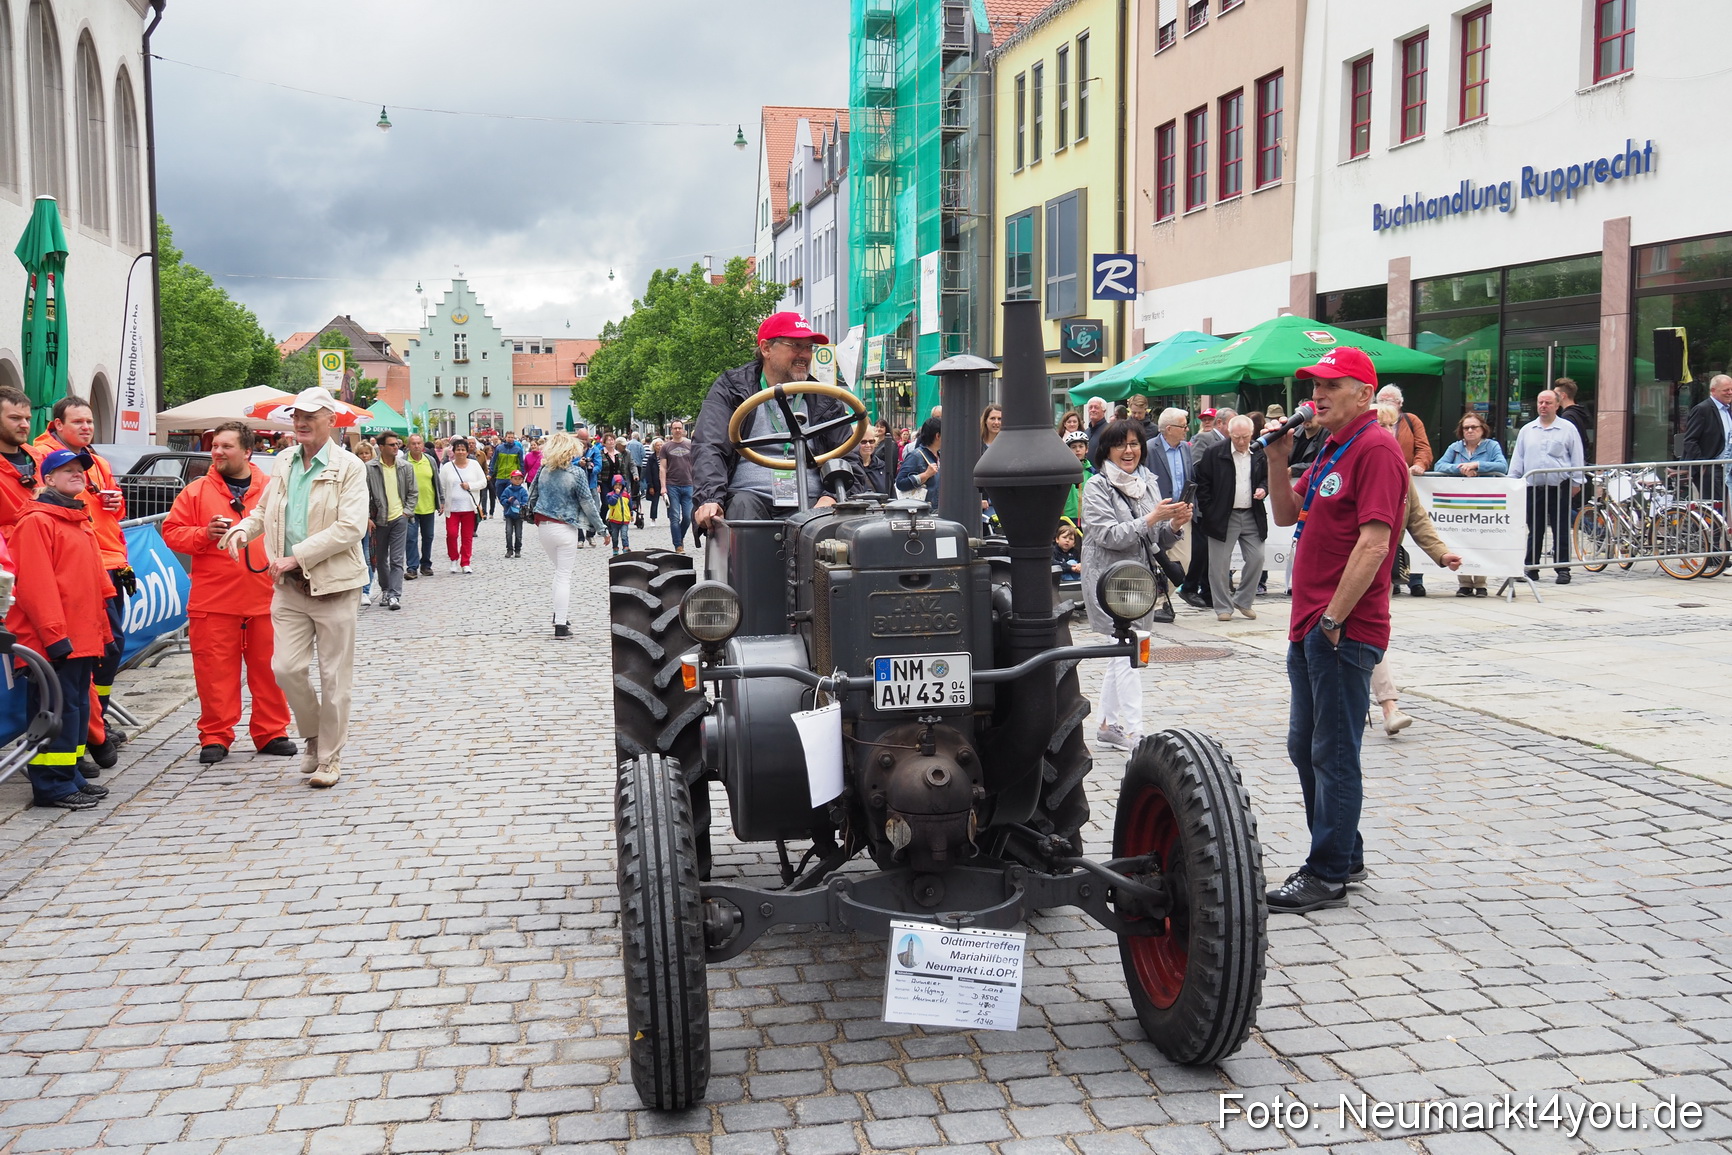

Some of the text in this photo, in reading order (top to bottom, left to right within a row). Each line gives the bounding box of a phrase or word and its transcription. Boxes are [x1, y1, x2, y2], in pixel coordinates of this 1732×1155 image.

[1373, 138, 1656, 231] Buchhandlung Rupprecht
[1077, 331, 1091, 349] G2
[1429, 512, 1510, 524] NeuerMarkt
[893, 659, 923, 681] NM
[951, 680, 965, 690] 04
[882, 681, 945, 706] AW 43
[951, 694, 965, 703] 09
[940, 936, 1020, 951] Oldtimertreffen
[950, 950, 1019, 967] Mariahilfberg
[925, 961, 978, 975] Neumarkt
